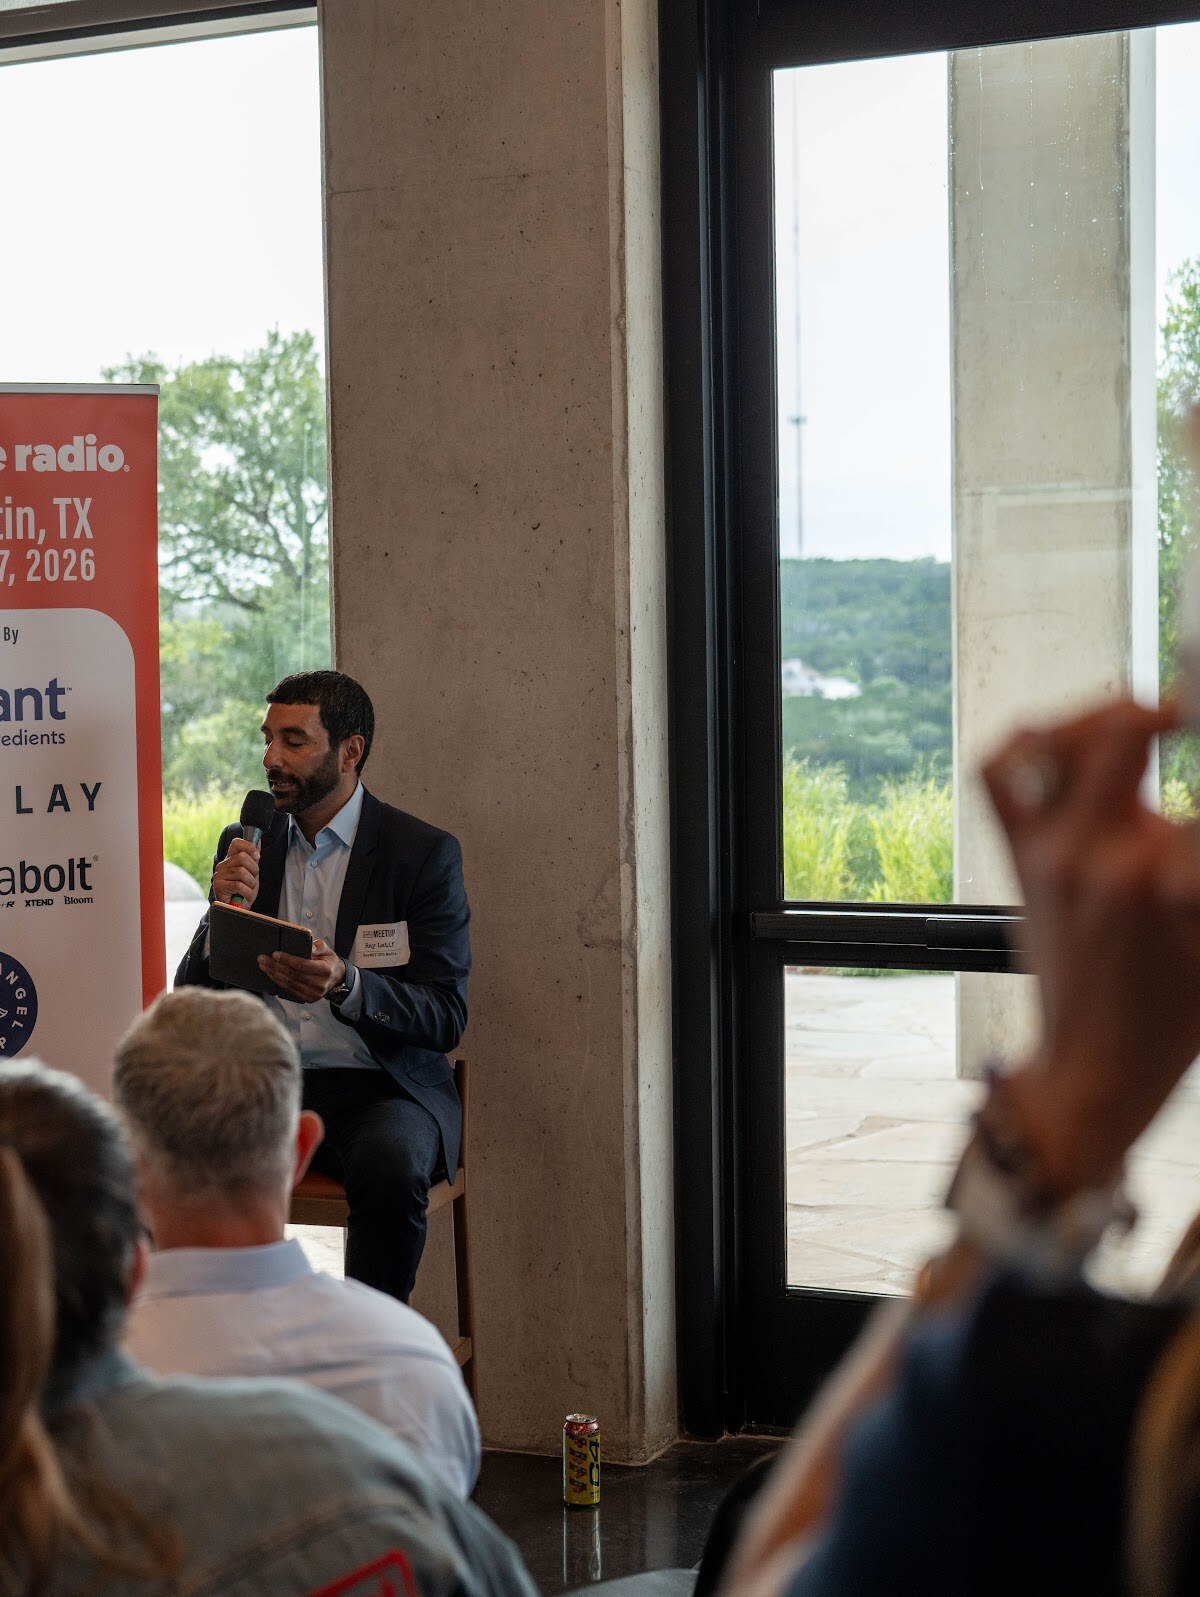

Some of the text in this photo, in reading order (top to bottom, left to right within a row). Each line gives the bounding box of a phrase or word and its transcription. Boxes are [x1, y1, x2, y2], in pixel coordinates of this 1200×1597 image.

[15, 433, 125, 473] radio
[53, 497, 94, 539] TX
[26, 548, 96, 582] 2026
[3, 626, 19, 645] By
[24, 898, 54, 908] XTEND
[63, 895, 94, 905] Bloom
[374, 929, 396, 938] MEETUP
